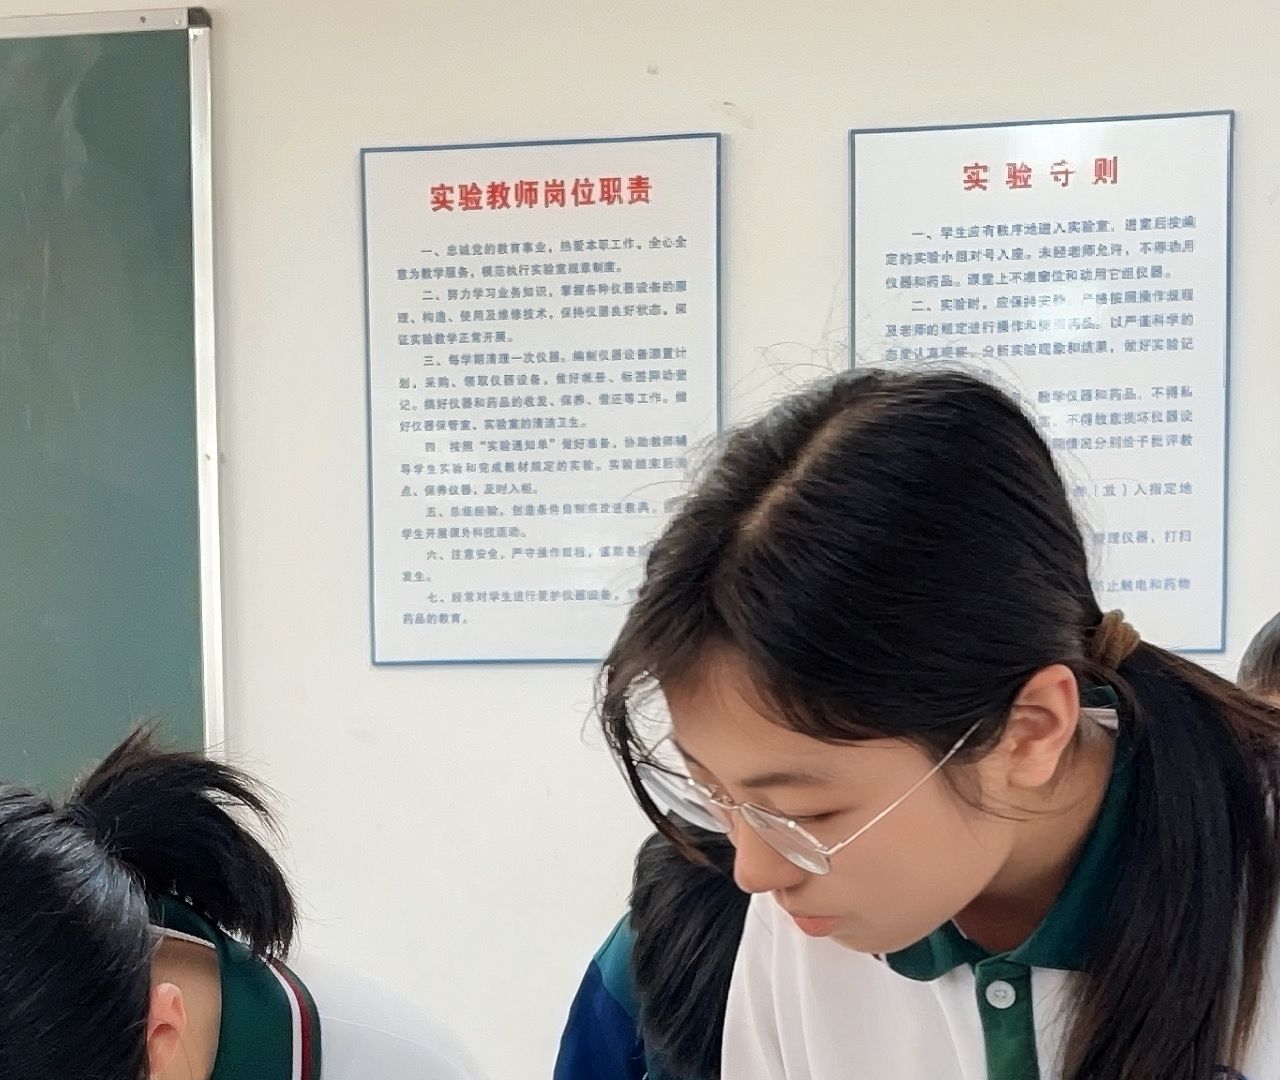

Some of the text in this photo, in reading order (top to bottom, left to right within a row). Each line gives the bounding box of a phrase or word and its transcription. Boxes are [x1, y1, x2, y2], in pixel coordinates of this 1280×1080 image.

[963, 155, 1119, 191] 实验守则
[430, 175, 653, 212] 实验教师岗位职责
